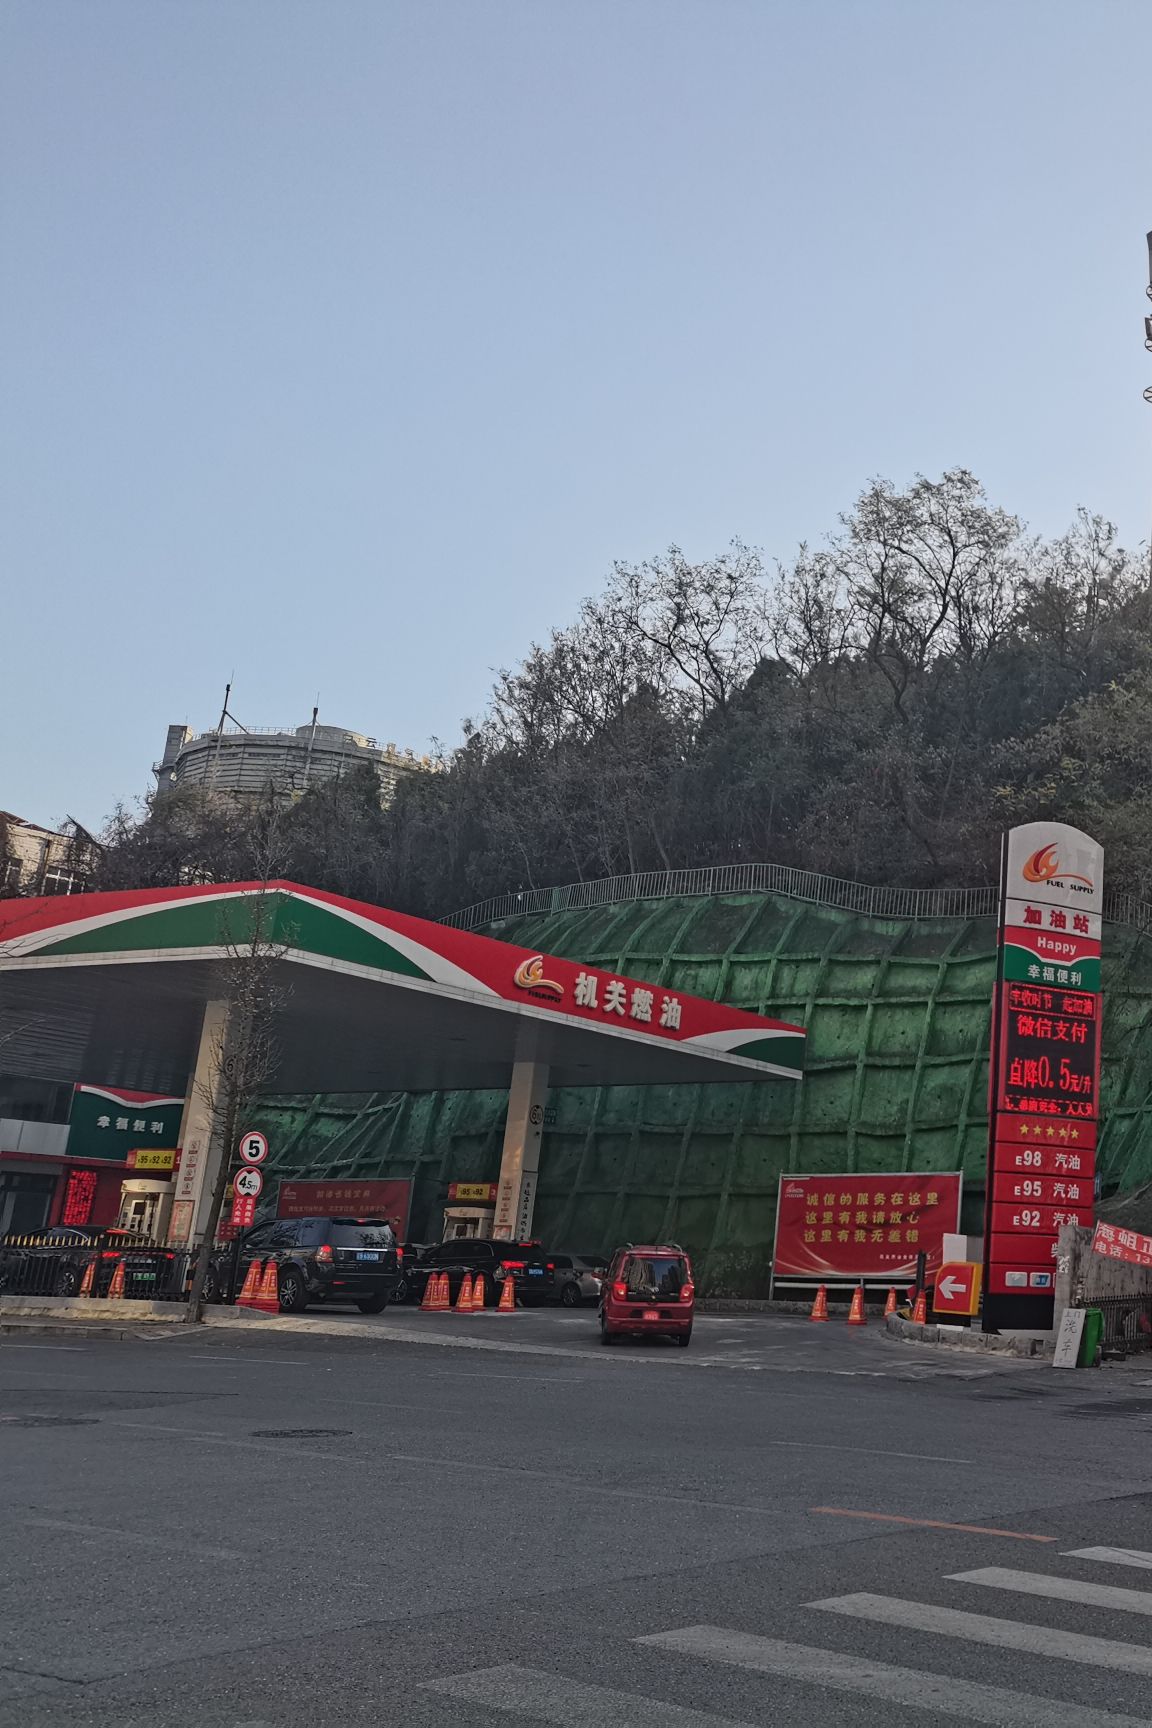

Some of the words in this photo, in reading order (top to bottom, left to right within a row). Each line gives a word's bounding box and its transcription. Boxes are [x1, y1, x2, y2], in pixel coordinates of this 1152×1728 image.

[1046, 879, 1065, 889] FUEL
[1070, 883, 1095, 895] SUPPLY
[1023, 906, 1090, 934] 加油站
[1037, 936, 1077, 956] Happy
[1027, 964, 1082, 986] 幸福便利
[573, 971, 682, 1030] 机关燃油
[1017, 1014, 1088, 1043] 微信支付
[96, 1115, 164, 1134] 幸福便利
[248, 1139, 260, 1158] 5
[1015, 1150, 1042, 1167] E98
[1055, 1153, 1081, 1170] 汽油
[806, 1191, 939, 1207] 诚信的服务在这里
[1014, 1180, 1042, 1197] E95
[1053, 1182, 1080, 1200] 汽油
[805, 1211, 921, 1225] 这里有我请放心
[1013, 1210, 1041, 1227] E92
[1053, 1212, 1079, 1228] 汽油
[804, 1229, 920, 1243] 这里有我无差错
